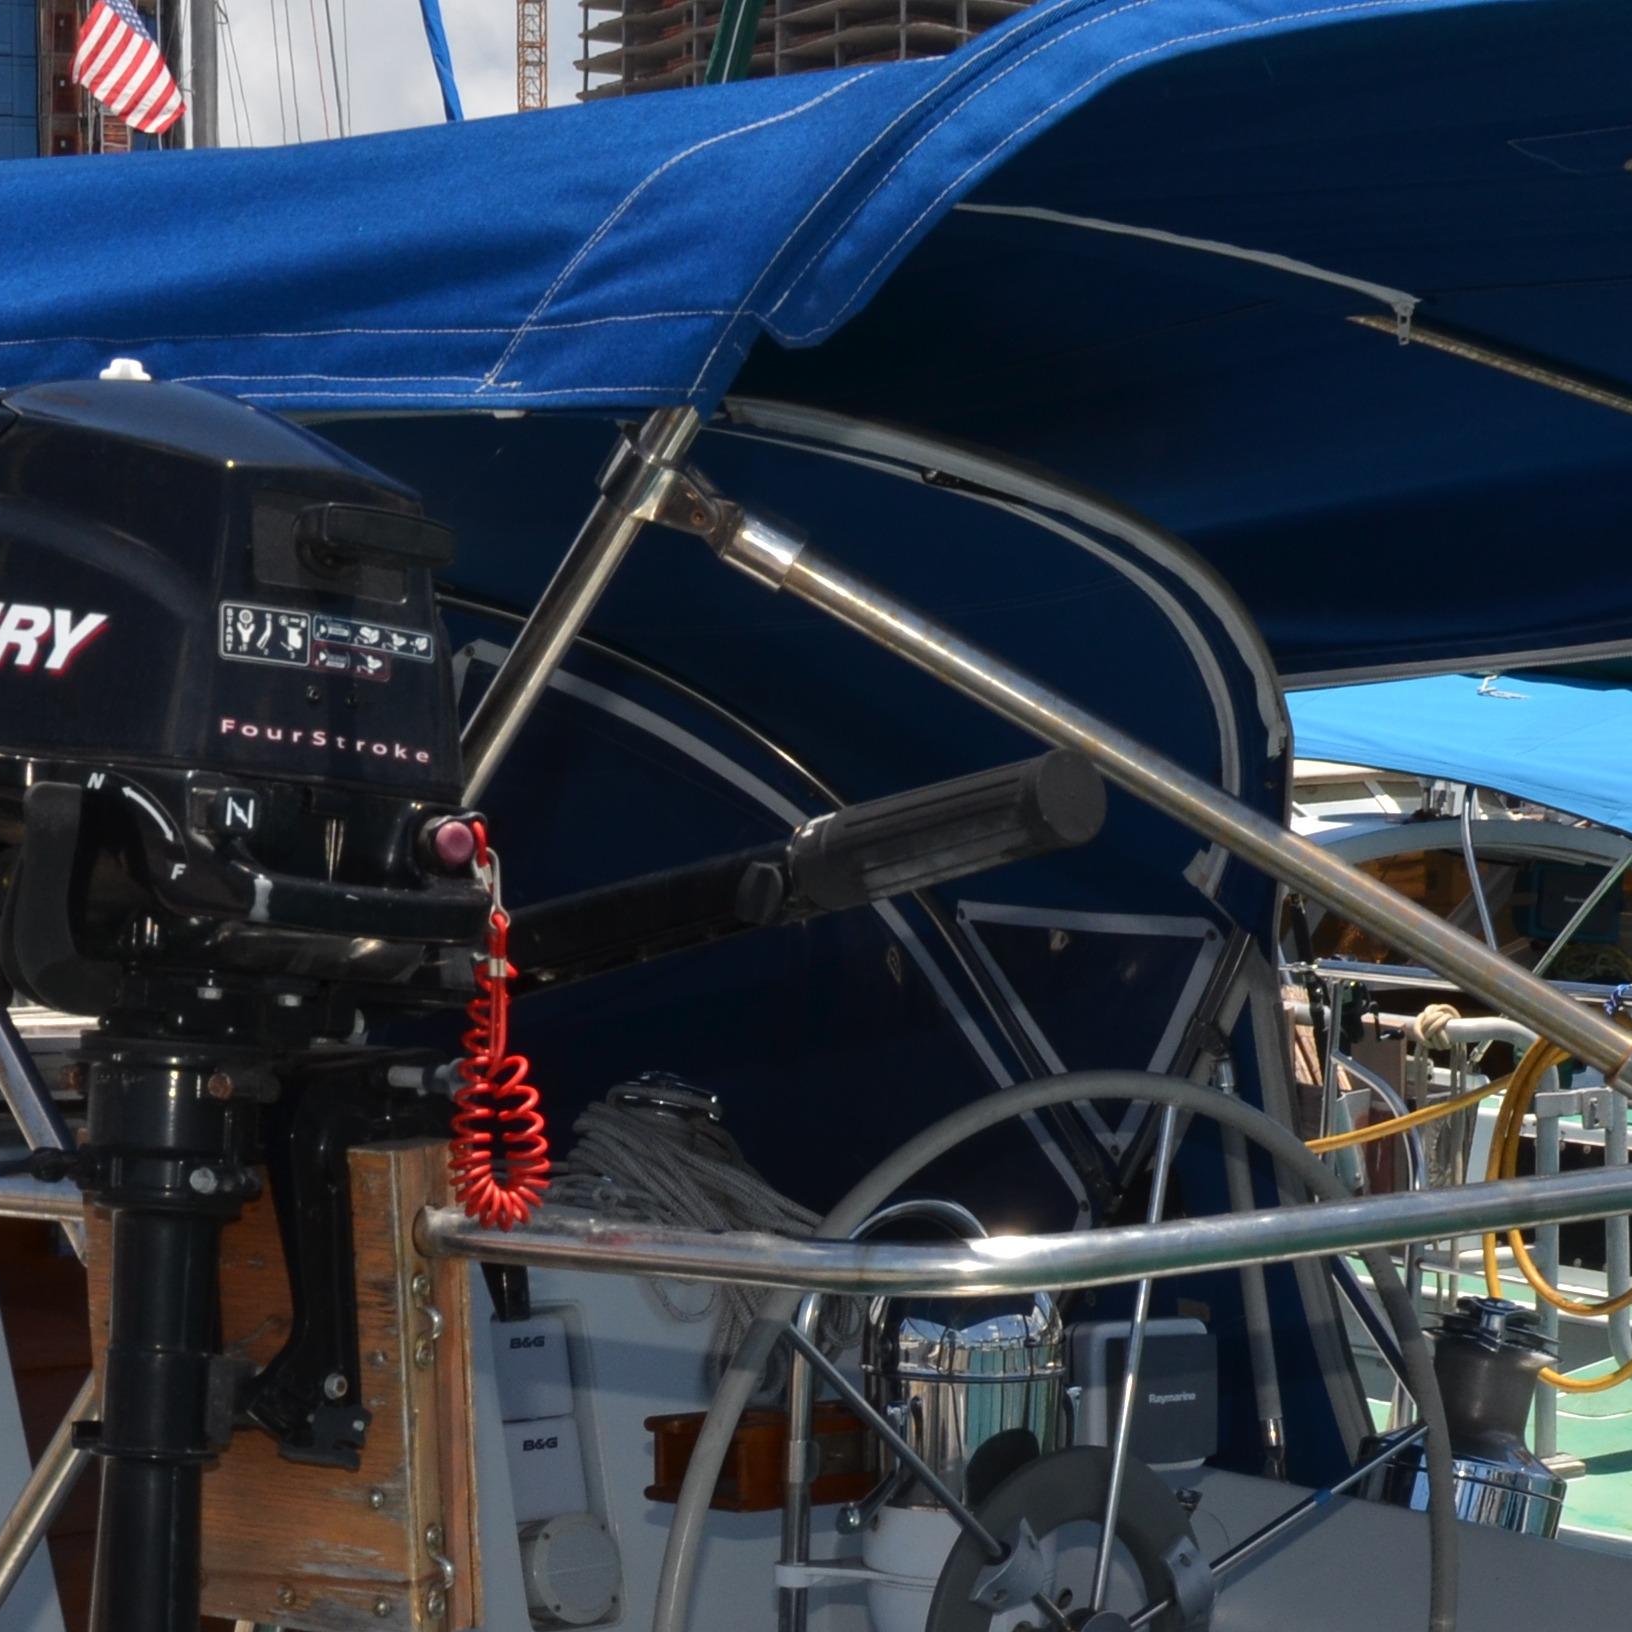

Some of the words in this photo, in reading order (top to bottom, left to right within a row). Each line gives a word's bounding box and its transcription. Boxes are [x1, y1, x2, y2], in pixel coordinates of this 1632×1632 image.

[220, 718, 430, 763] FourStroke
[87, 771, 106, 790] N
[171, 863, 187, 881] F
[509, 1335, 545, 1350] B&G
[523, 1436, 559, 1452] B&G
